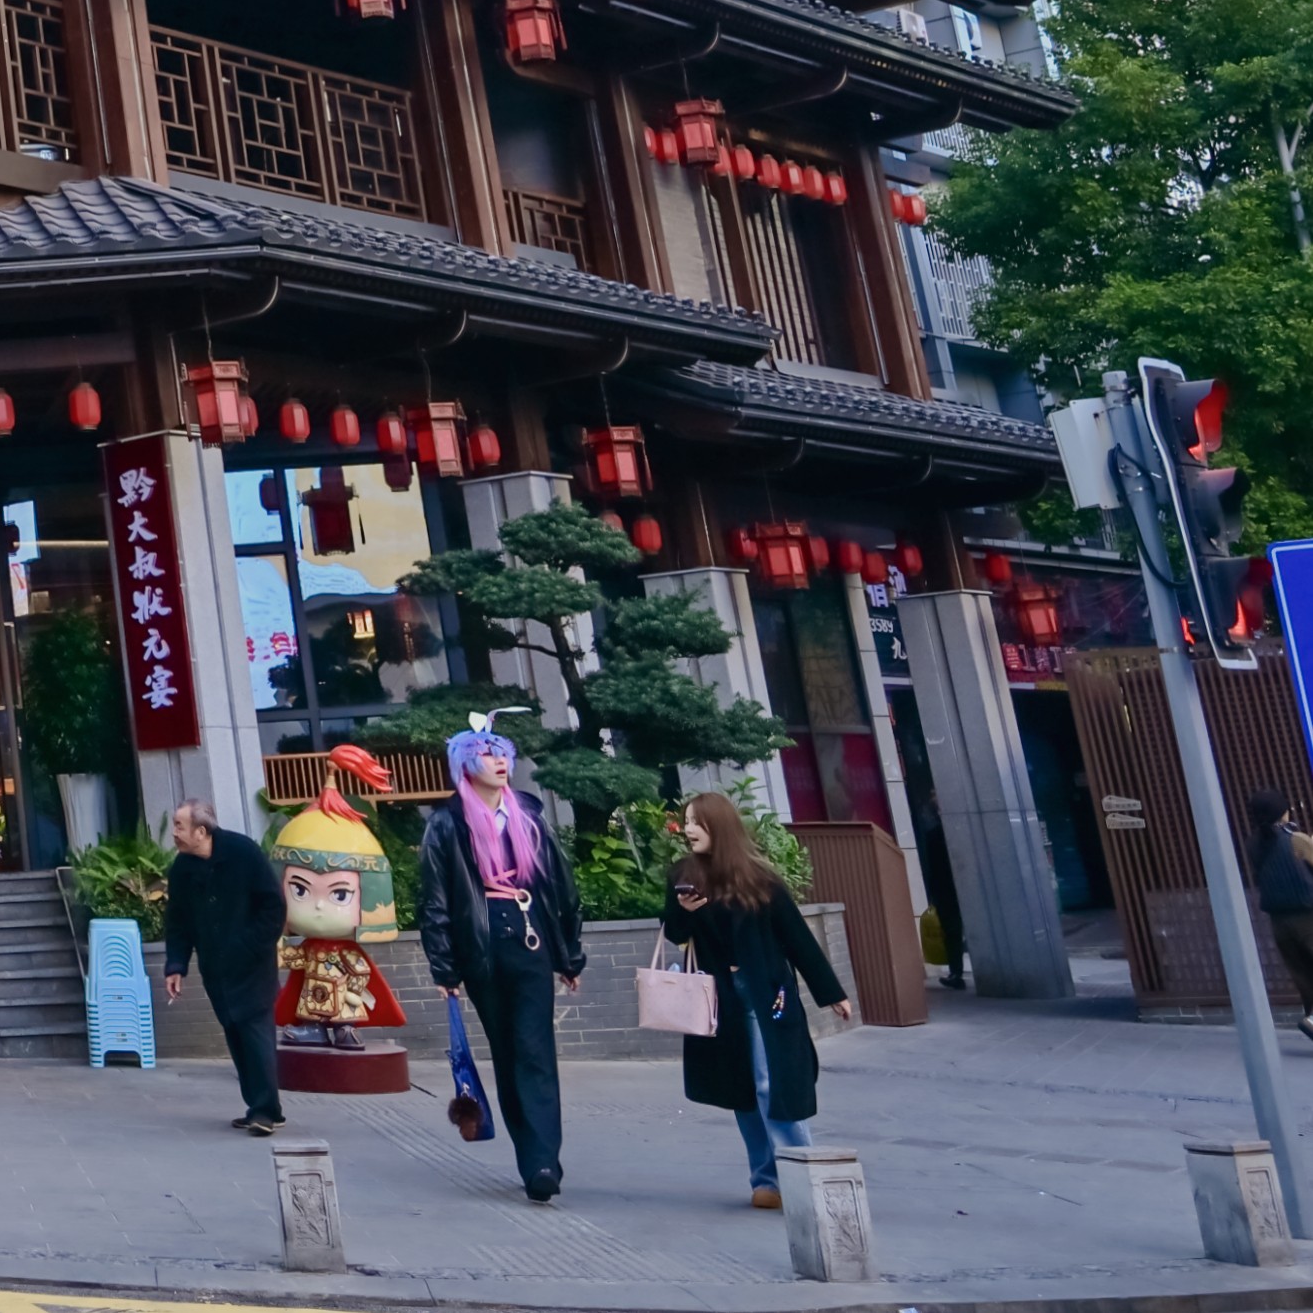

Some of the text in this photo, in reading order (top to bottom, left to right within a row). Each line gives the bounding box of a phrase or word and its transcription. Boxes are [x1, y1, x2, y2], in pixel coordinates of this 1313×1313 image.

[117, 466, 178, 710] 黔大叔状元宴
